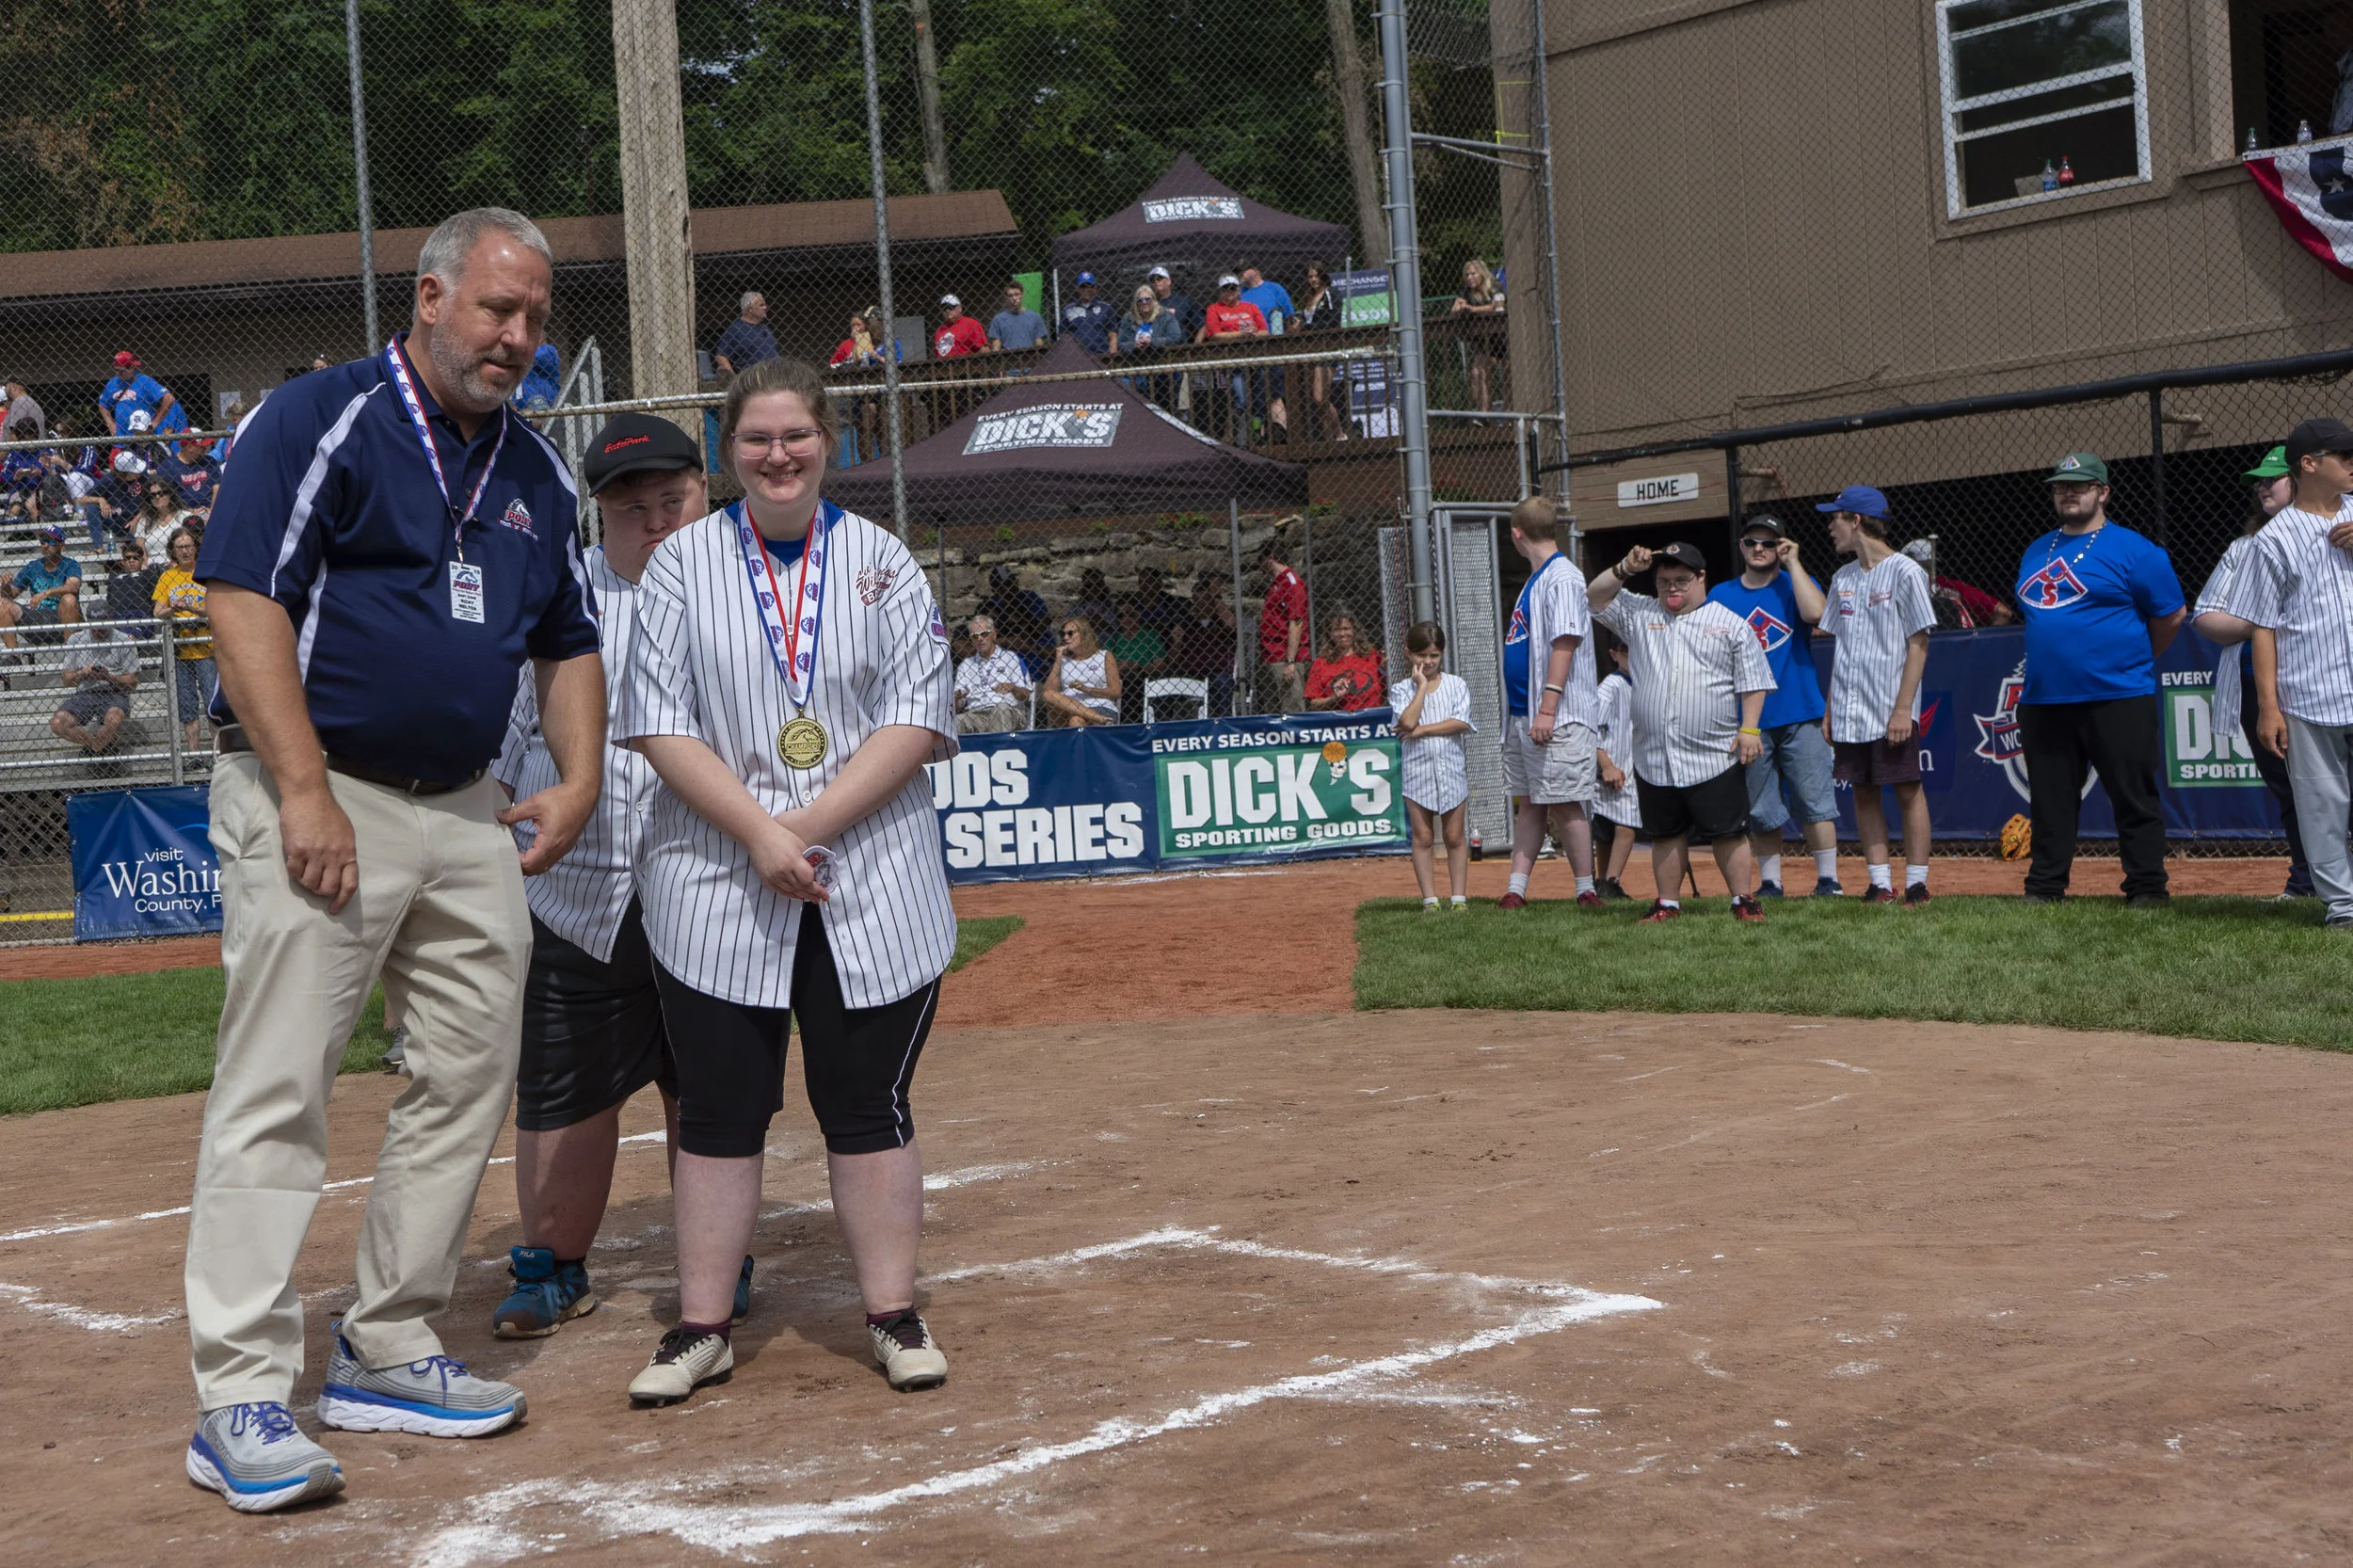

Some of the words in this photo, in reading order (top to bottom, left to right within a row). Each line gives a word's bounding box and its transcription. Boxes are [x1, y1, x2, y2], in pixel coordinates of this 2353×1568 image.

[1015, 403, 1062, 416] SEASON
[1063, 403, 1106, 411] STARTS
[974, 411, 1114, 445] DICK'S
[1637, 478, 1679, 501] HOME
[453, 580, 480, 591] PONY
[2161, 670, 2213, 686] EVERY
[1152, 736, 1213, 753] EVERY
[1218, 730, 1296, 749] SEASON
[1300, 724, 1371, 744] STARTS
[1167, 747, 1392, 829] DICK'S
[945, 802, 1144, 869] SERIES
[1176, 825, 1298, 849] SPORTING
[144, 847, 184, 862] visit
